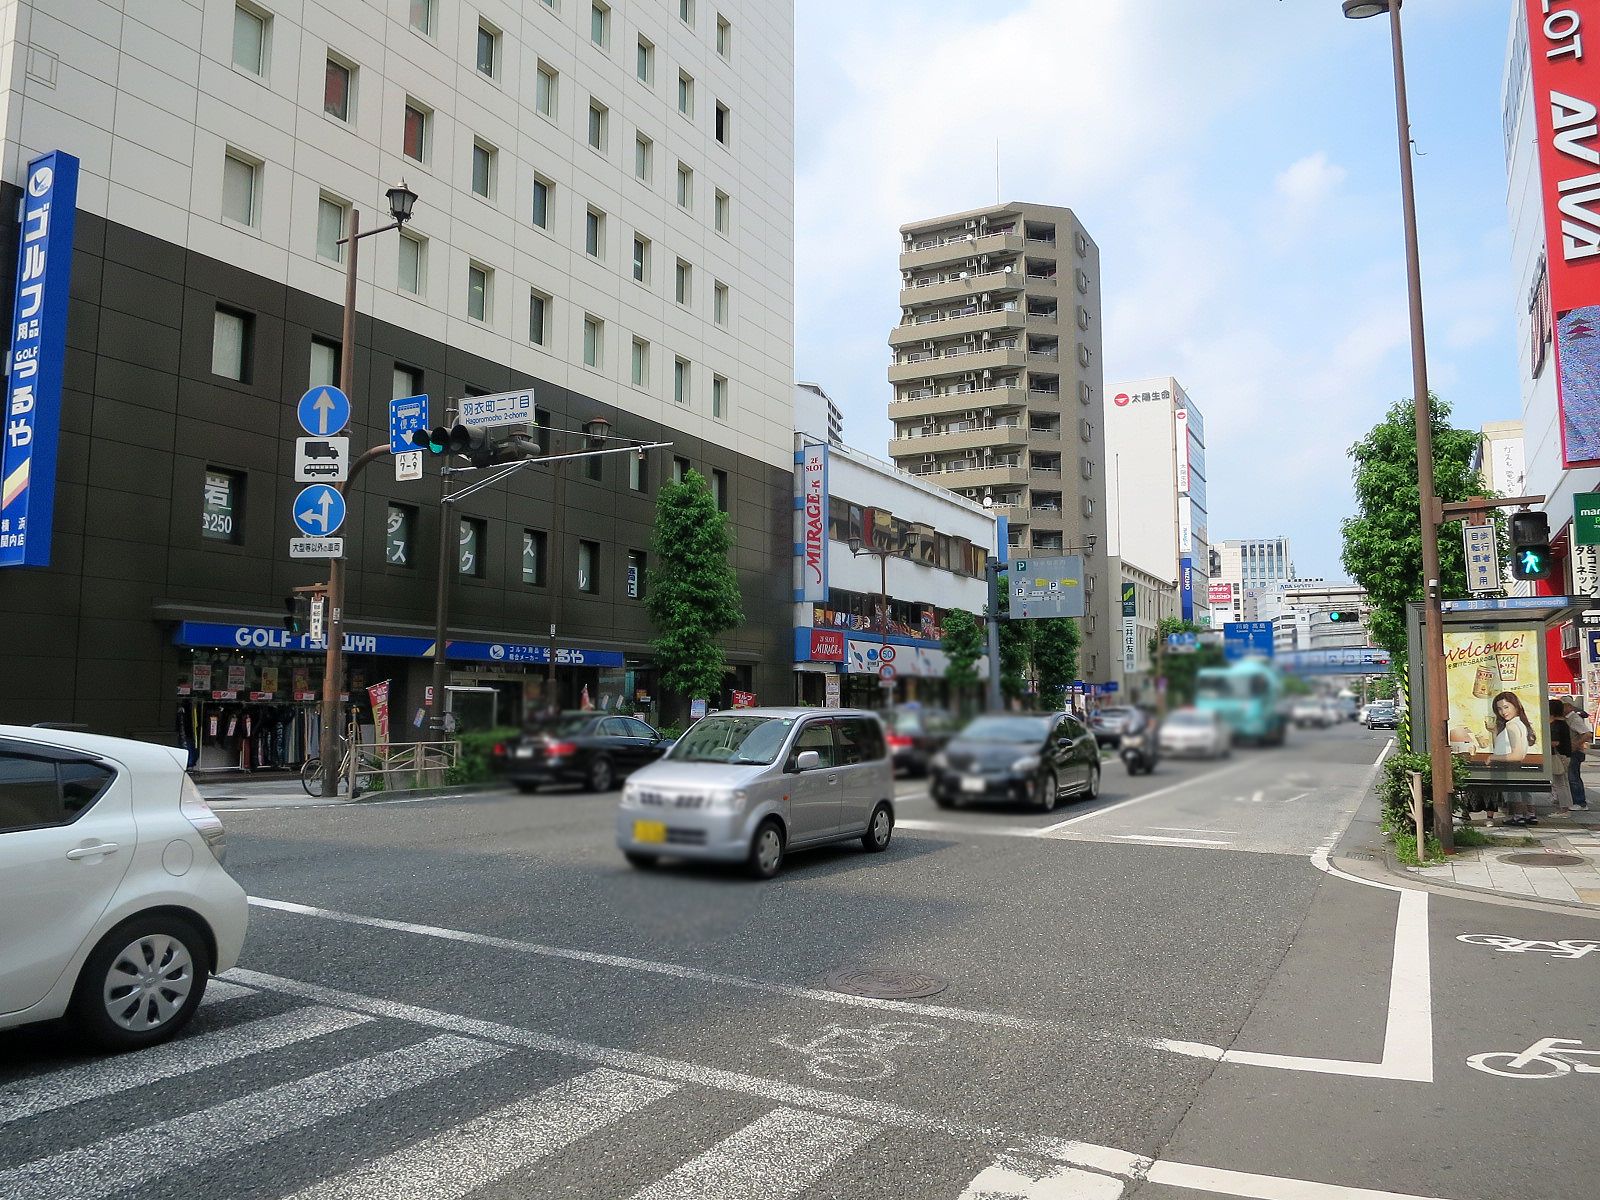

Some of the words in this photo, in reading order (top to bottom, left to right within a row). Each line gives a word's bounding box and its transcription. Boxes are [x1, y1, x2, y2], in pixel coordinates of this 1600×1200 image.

[1542, 0, 1582, 59] OT
[15, 346, 39, 361] GOLF
[9, 358, 38, 447] つるや
[1131, 390, 1170, 403] 太陽生命
[463, 395, 530, 416] 羽衣町二丁目
[400, 418, 418, 430] 優先
[465, 415, 503, 425] Hagoromocho
[503, 411, 528, 420] 2-chome
[805, 464, 823, 472] SLOT
[235, 627, 292, 648] GOLF
[882, 650, 893, 659] 50
